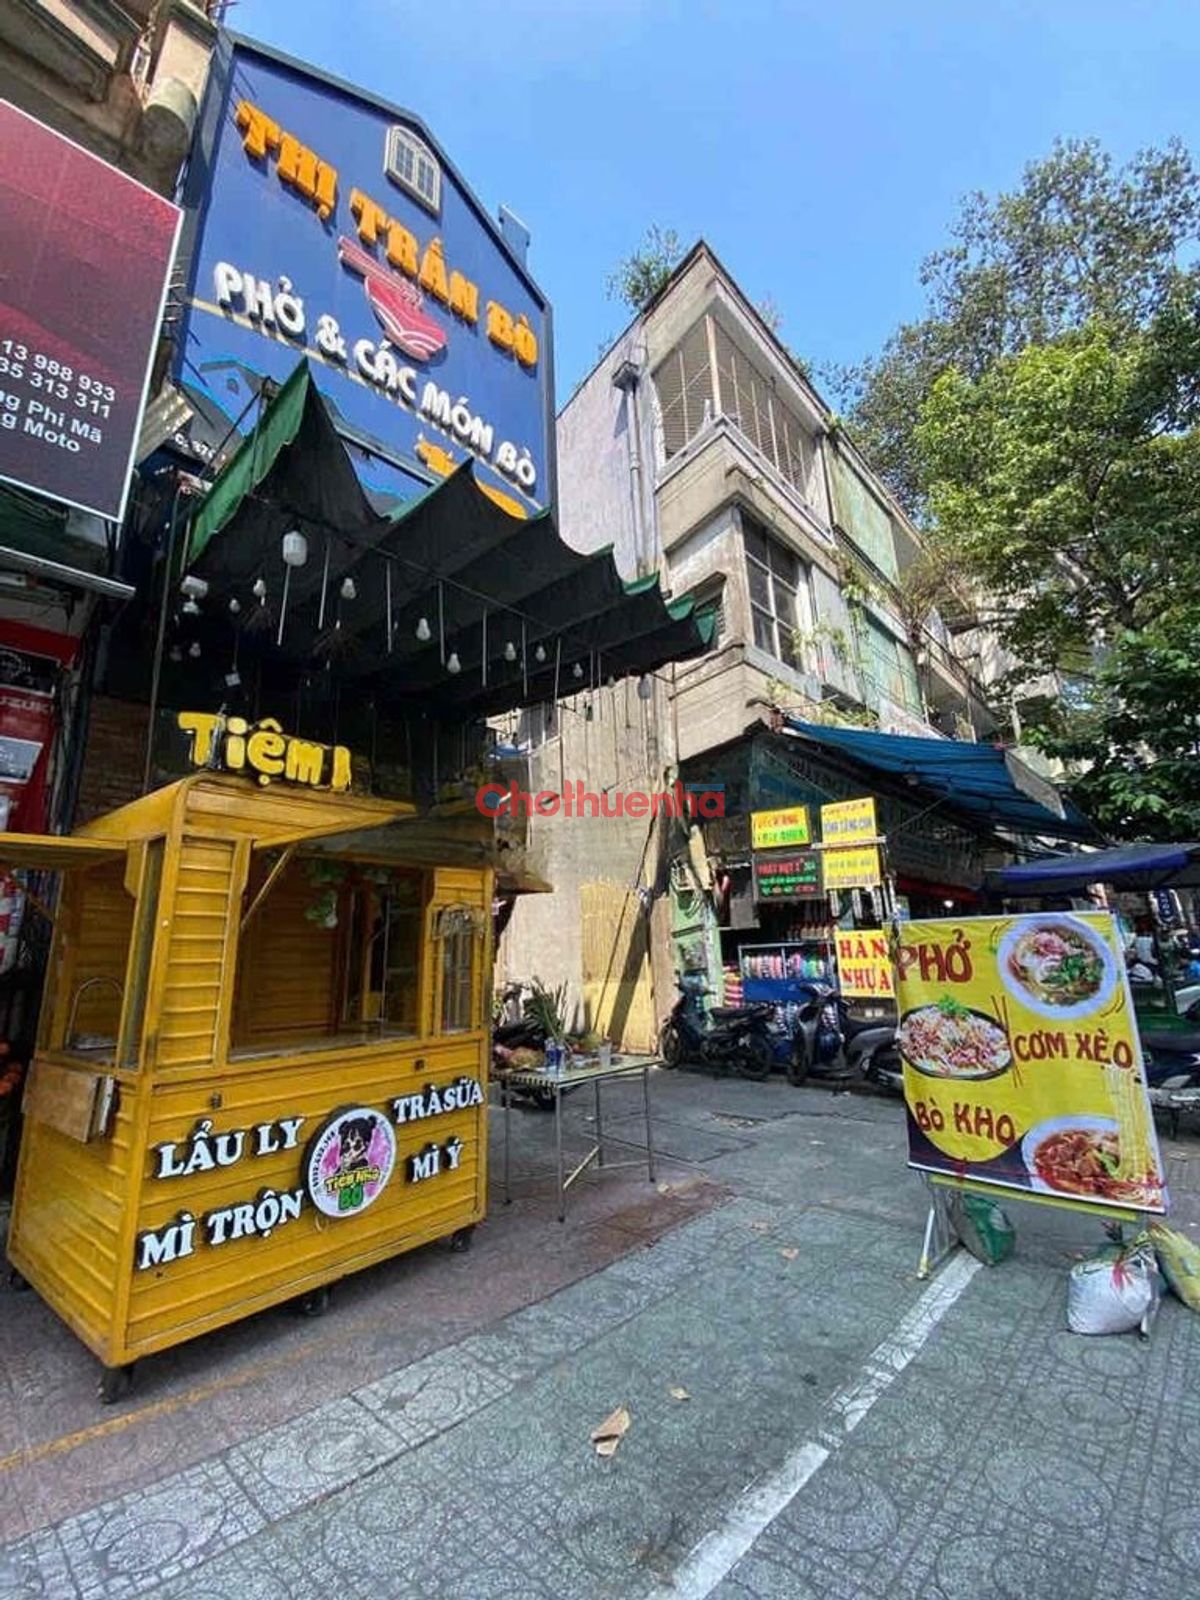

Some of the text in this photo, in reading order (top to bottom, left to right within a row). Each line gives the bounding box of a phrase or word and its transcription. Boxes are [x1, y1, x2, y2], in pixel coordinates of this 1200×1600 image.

[234, 100, 338, 219] THỊ
[485, 301, 538, 367] BÒ
[29, 371, 69, 399] 313
[74, 392, 111, 418] 311
[34, 354, 73, 381] 988
[78, 374, 115, 401] 933
[213, 262, 306, 335] PHỞ
[315, 314, 348, 359] &
[355, 338, 417, 400] CÁC
[421, 381, 494, 454] MÓN
[496, 441, 536, 487] BÒ
[24, 417, 81, 452] Moto
[178, 711, 324, 786] Tiệm
[897, 928, 974, 983] PHỞ
[1014, 1032, 1068, 1062] CƠM
[158, 1117, 306, 1179] LẨU LY
[953, 1102, 1016, 1146] KHO
[412, 1144, 440, 1183] MÌ
[447, 1137, 464, 1170] Ý
[139, 1189, 304, 1270] MÌ TRỘN
